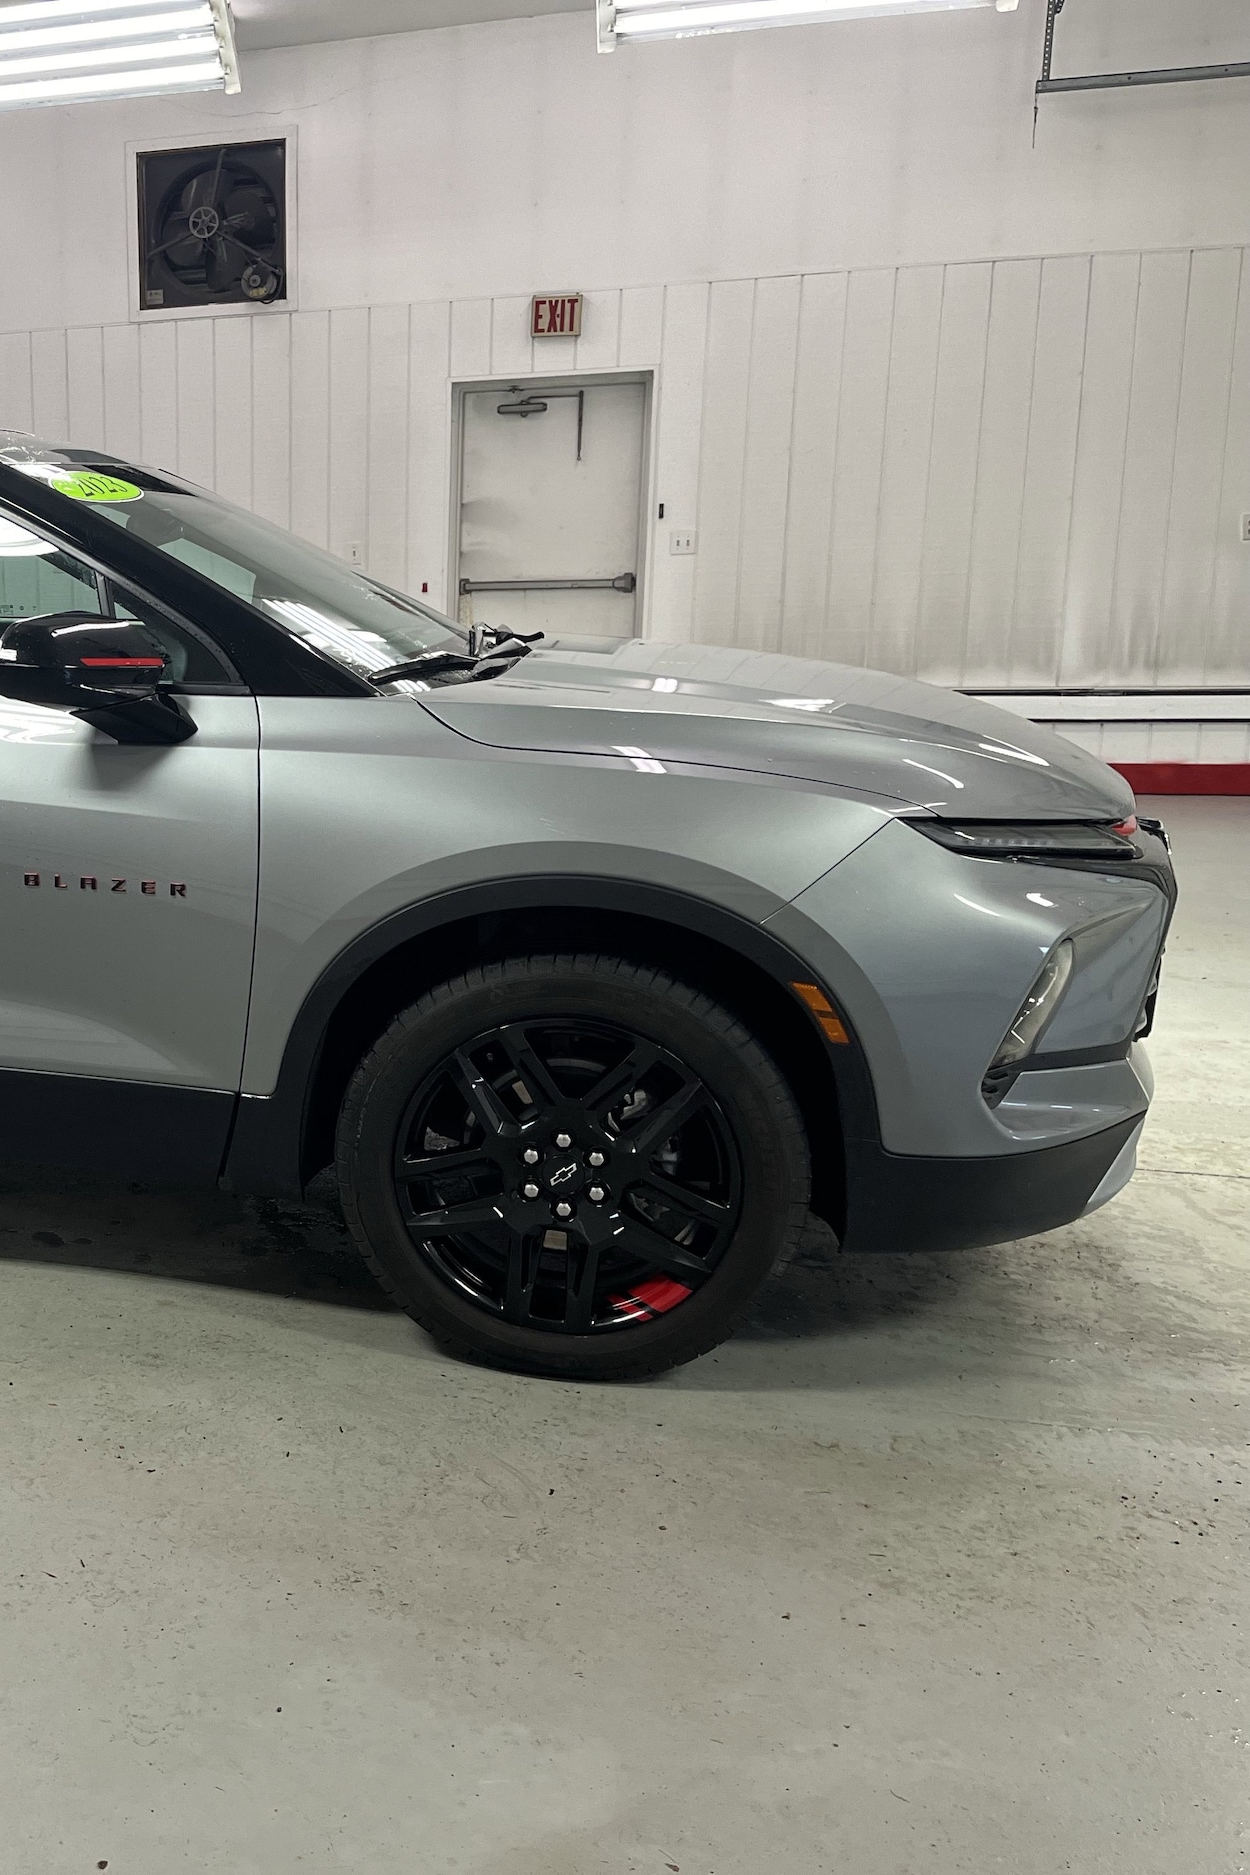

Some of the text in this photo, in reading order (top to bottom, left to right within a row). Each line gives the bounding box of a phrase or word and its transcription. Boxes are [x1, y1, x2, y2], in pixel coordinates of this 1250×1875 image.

[534, 299, 579, 333] EXIT
[76, 476, 128, 497] 2023
[24, 872, 187, 897] BLAZER
